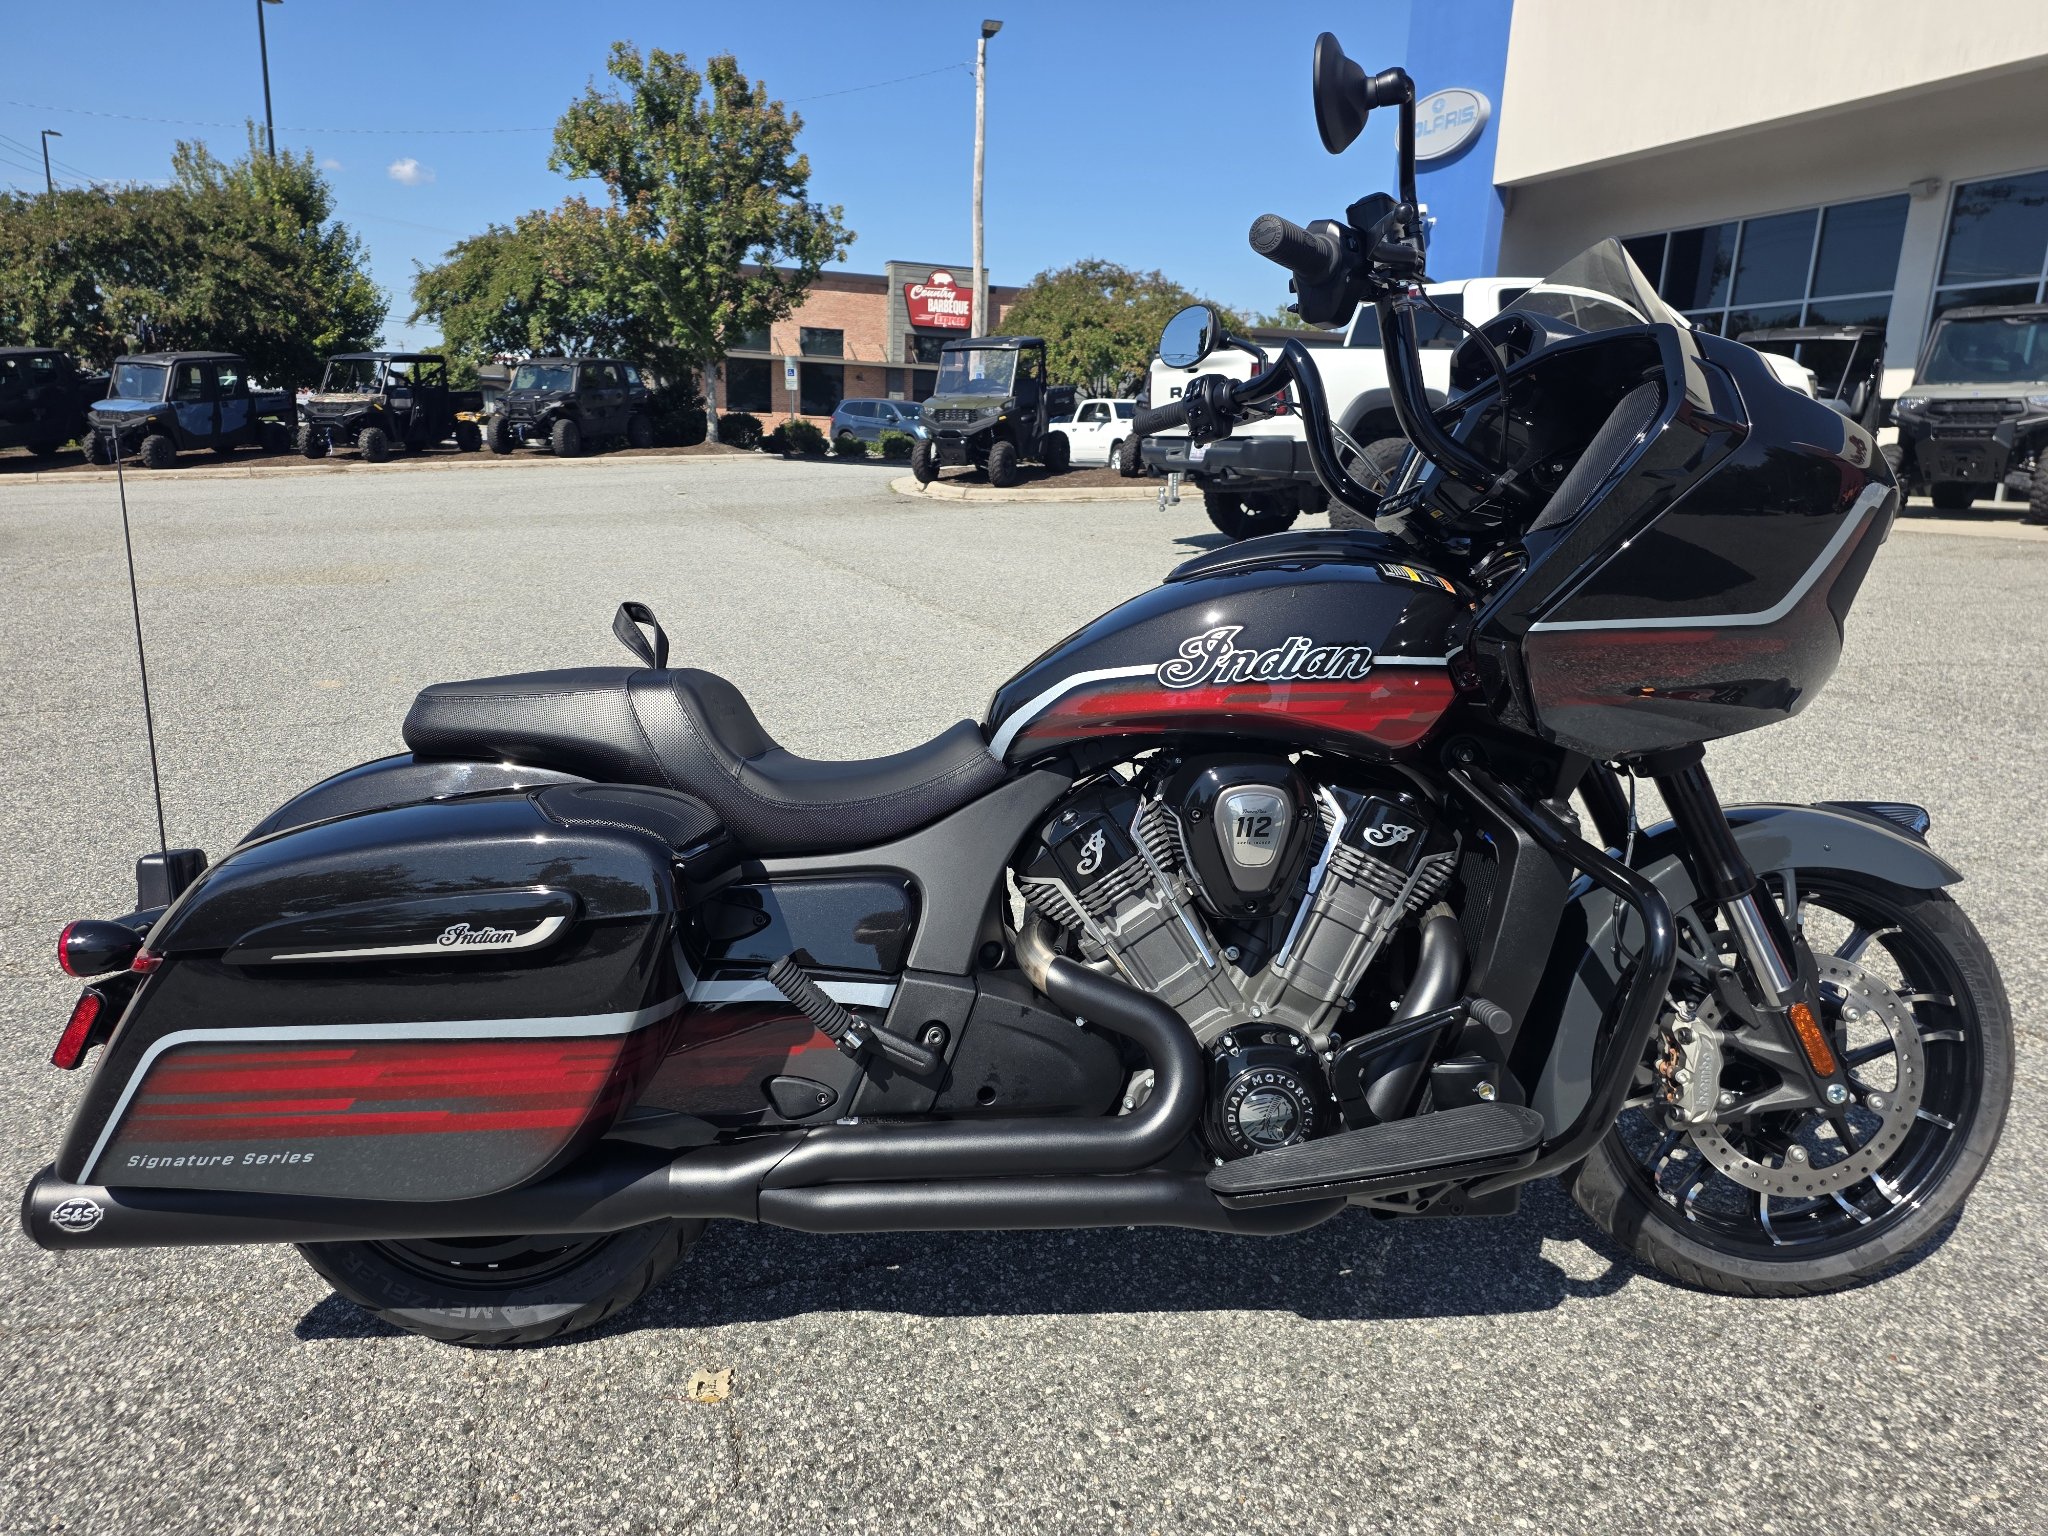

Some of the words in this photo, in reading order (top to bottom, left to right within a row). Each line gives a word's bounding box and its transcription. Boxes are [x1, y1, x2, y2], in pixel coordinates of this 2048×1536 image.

[1415, 105, 1475, 138] OLARIS
[910, 285, 956, 301] Country
[928, 298, 970, 315] BARBEQUE
[934, 313, 967, 327] Express
[1157, 625, 1373, 688] Indian
[1236, 816, 1272, 838] 112
[438, 923, 516, 947] Indian
[1227, 1084, 1248, 1142] INDIAN
[1252, 1073, 1314, 1144] MOTORCYCLE
[127, 1154, 235, 1169] Signature
[242, 1151, 315, 1165] Series
[57, 1207, 97, 1222] S&S
